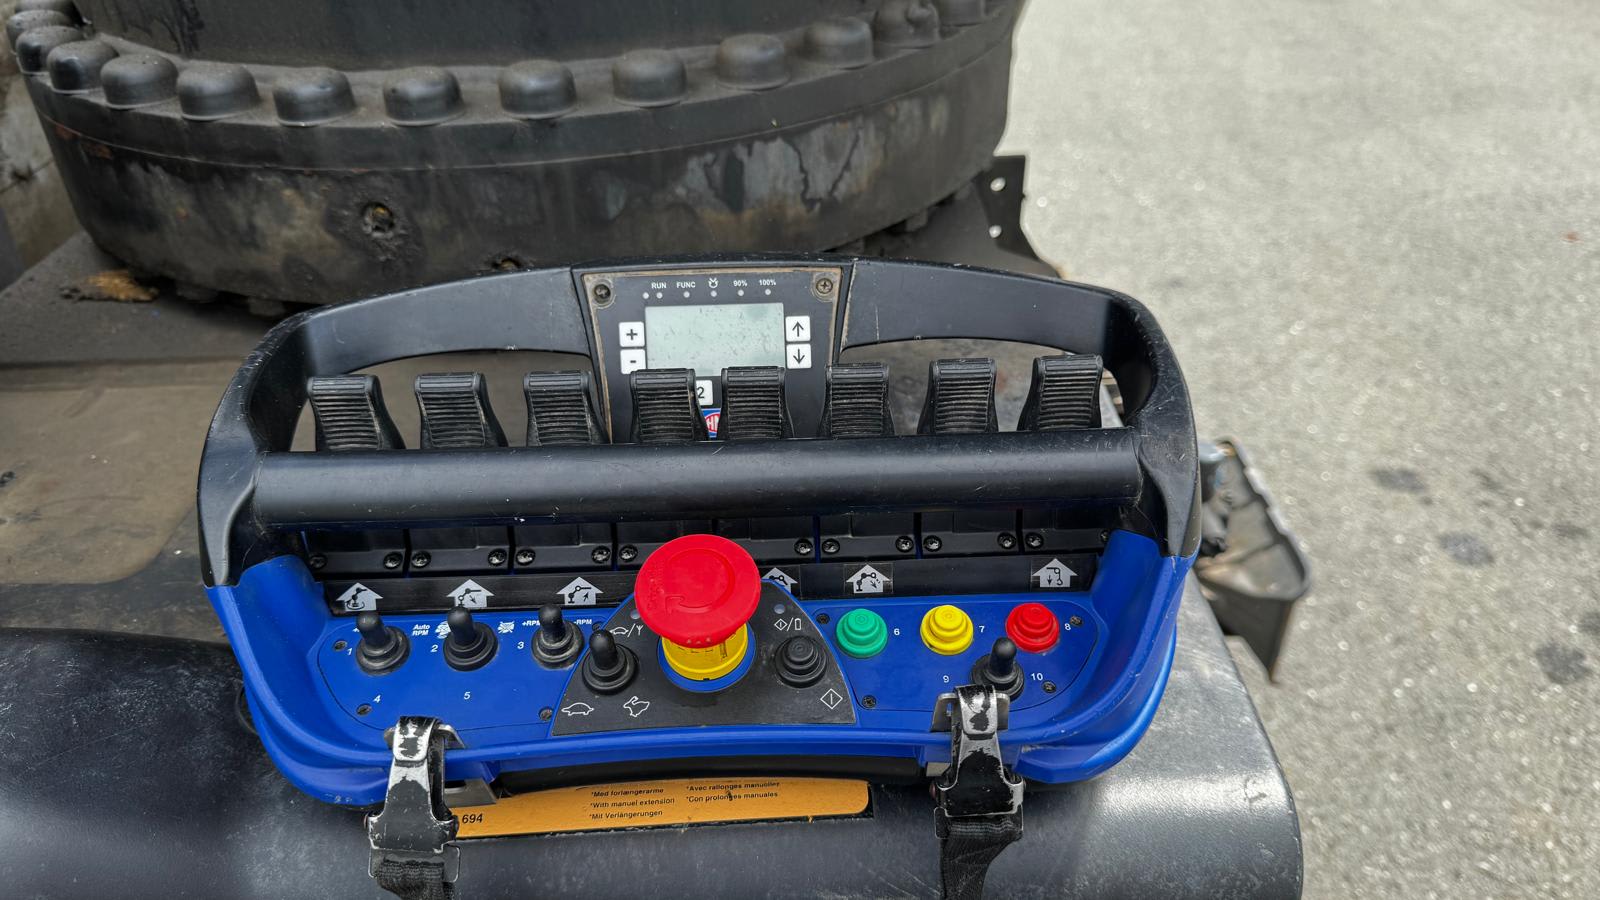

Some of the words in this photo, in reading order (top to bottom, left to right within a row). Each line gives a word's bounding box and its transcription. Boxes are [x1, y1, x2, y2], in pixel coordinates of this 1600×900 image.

[676, 281, 696, 289] FUNC
[697, 386, 705, 399] 2
[979, 625, 986, 633] 7
[1065, 623, 1072, 631] 8
[893, 628, 901, 636] 6
[430, 644, 439, 653] 2
[517, 641, 525, 650] 3
[347, 648, 353, 656] 1
[943, 675, 950, 684] 9
[1031, 672, 1044, 681] 10
[373, 694, 381, 703] 4
[463, 691, 471, 700] 5
[461, 813, 483, 824] 694
